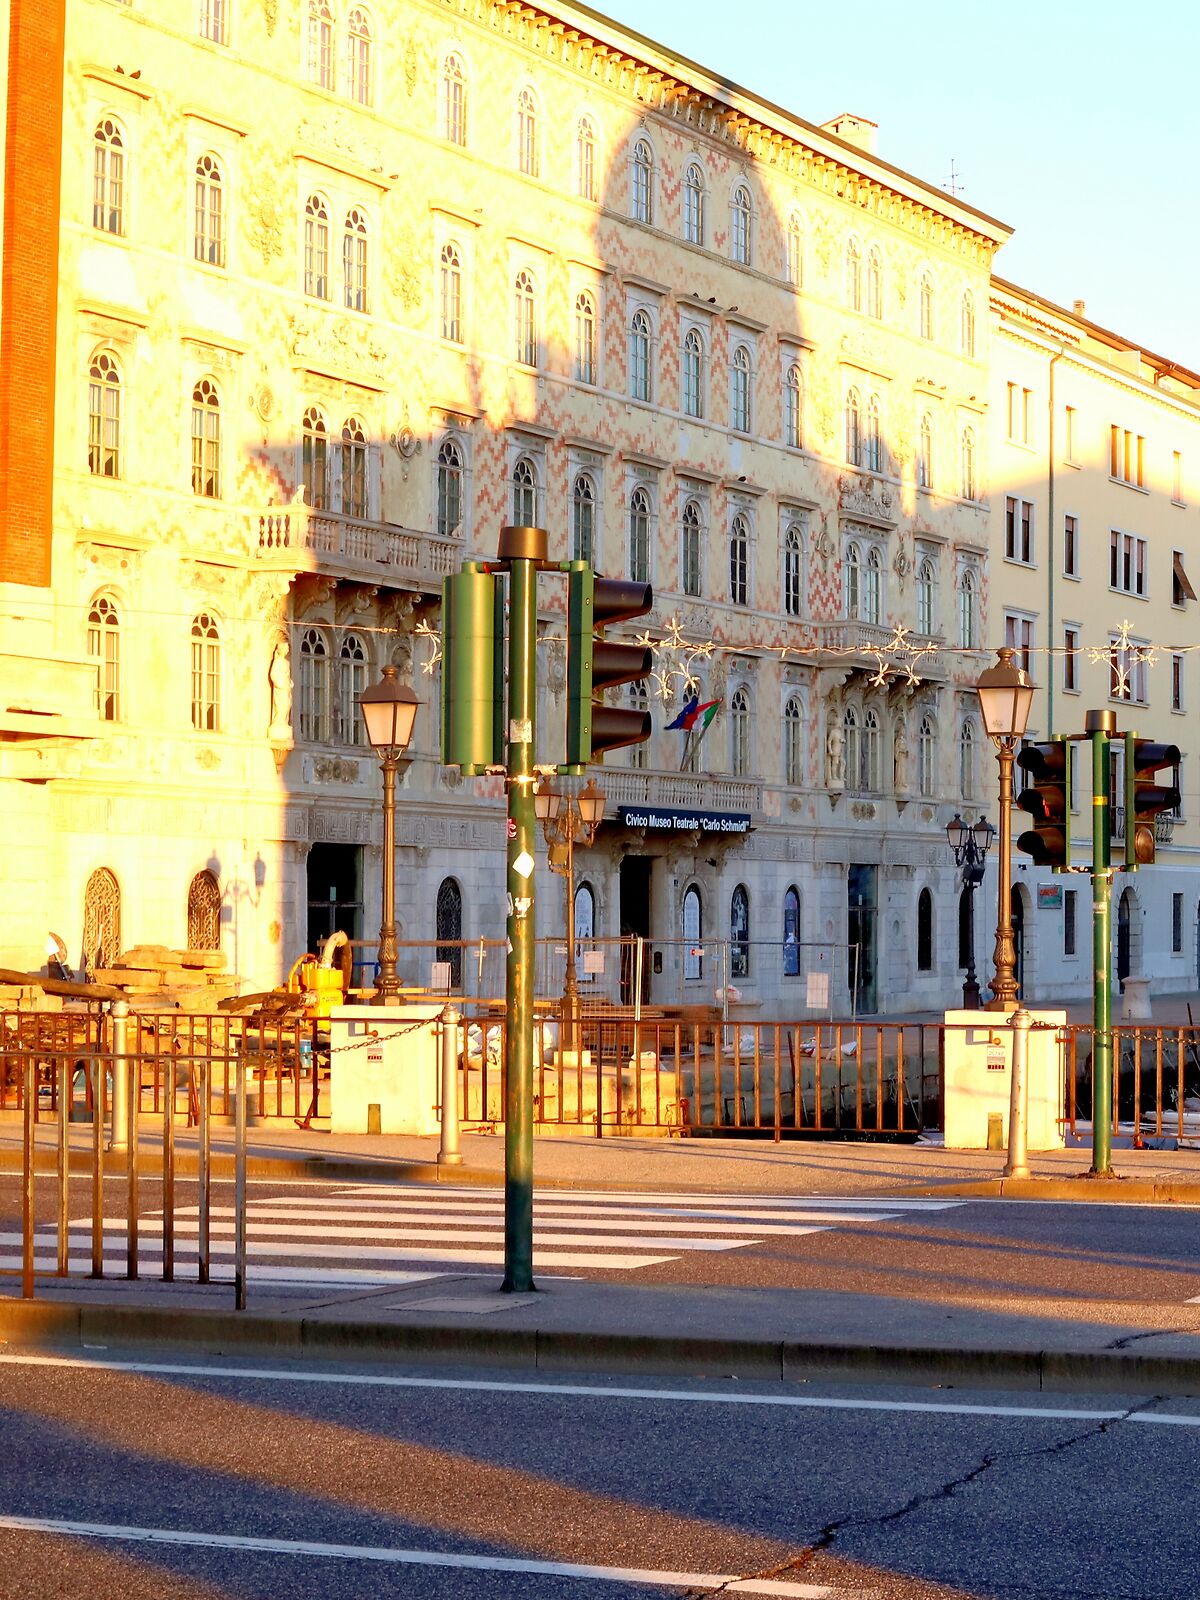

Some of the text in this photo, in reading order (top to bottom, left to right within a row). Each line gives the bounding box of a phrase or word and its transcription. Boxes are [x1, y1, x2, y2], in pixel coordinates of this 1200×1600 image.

[626, 813, 648, 827] Civico
[649, 814, 672, 828] Museo
[672, 816, 699, 830] Teatrale
